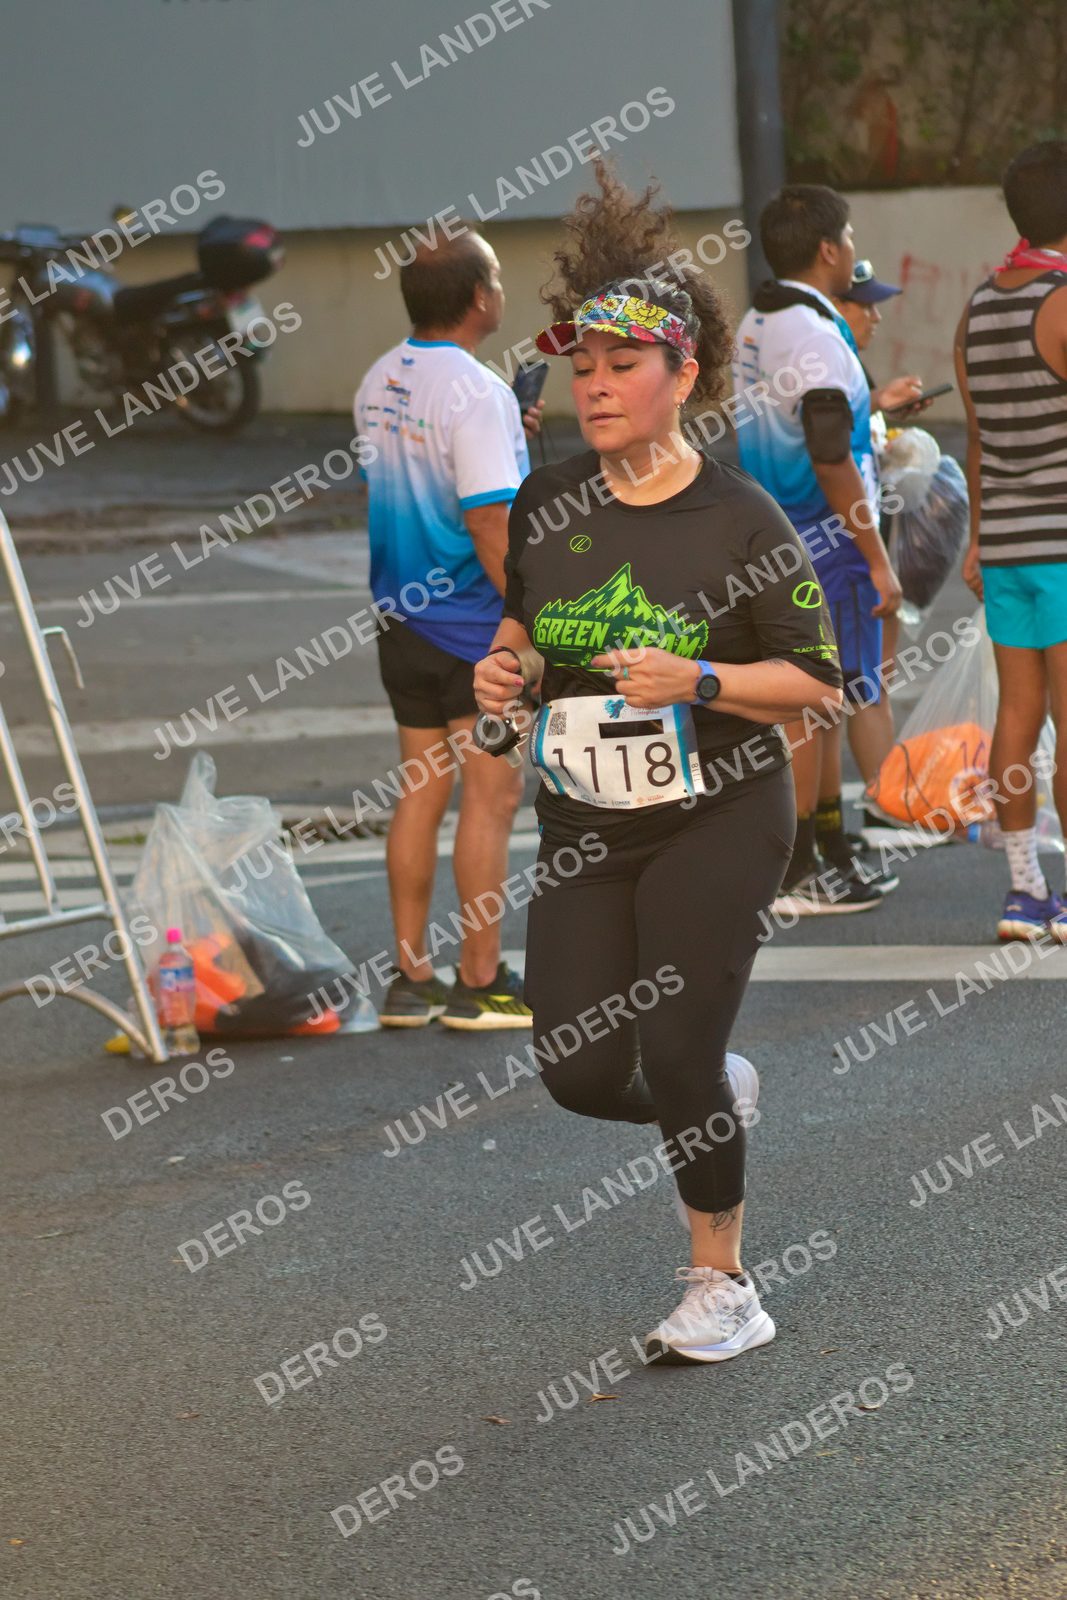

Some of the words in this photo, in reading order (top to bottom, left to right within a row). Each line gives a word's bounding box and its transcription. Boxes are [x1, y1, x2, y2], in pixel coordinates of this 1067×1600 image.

[536, 617, 610, 649] GREEN
[623, 625, 701, 660] TEAM
[552, 742, 676, 793] 1118
